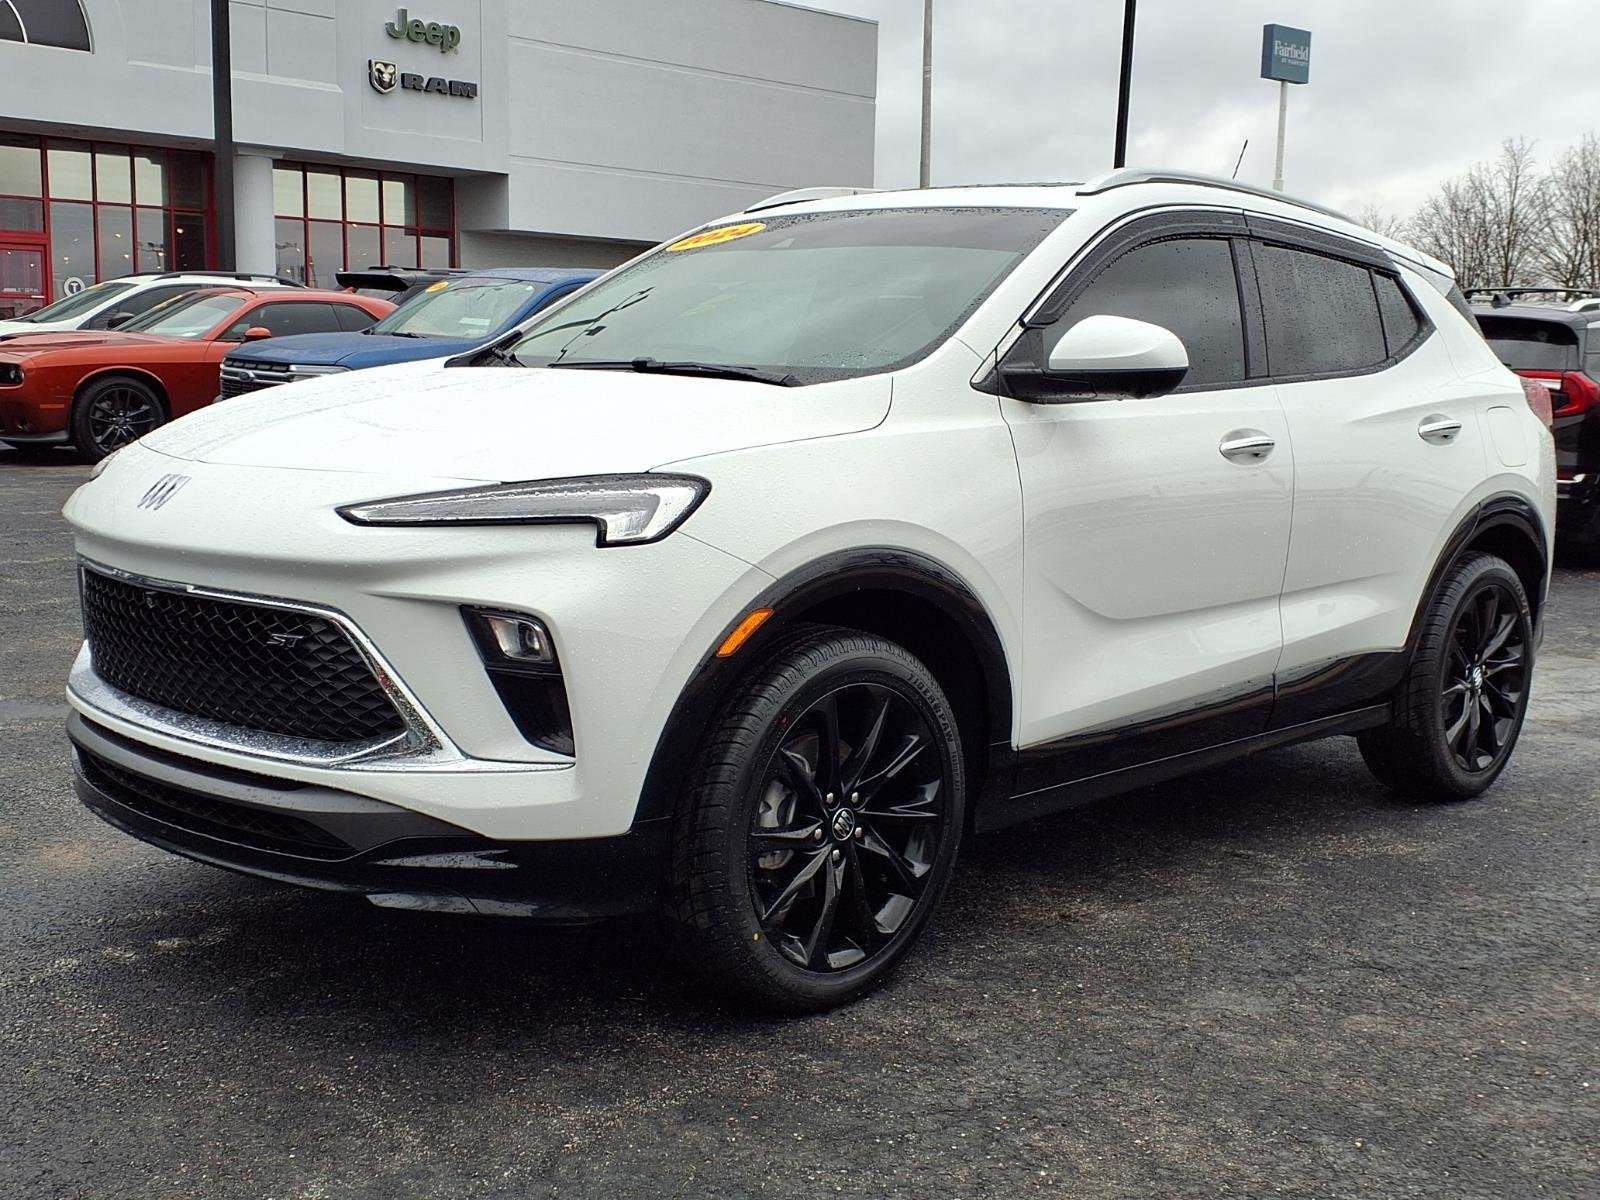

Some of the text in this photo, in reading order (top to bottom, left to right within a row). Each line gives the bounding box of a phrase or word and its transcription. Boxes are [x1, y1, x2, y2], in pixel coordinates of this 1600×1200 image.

[385, 8, 461, 53] Jeep
[1274, 40, 1309, 61] Fairfield
[401, 72, 477, 98] RAM
[266, 633, 304, 650] ST
[938, 712, 954, 743] PAW
